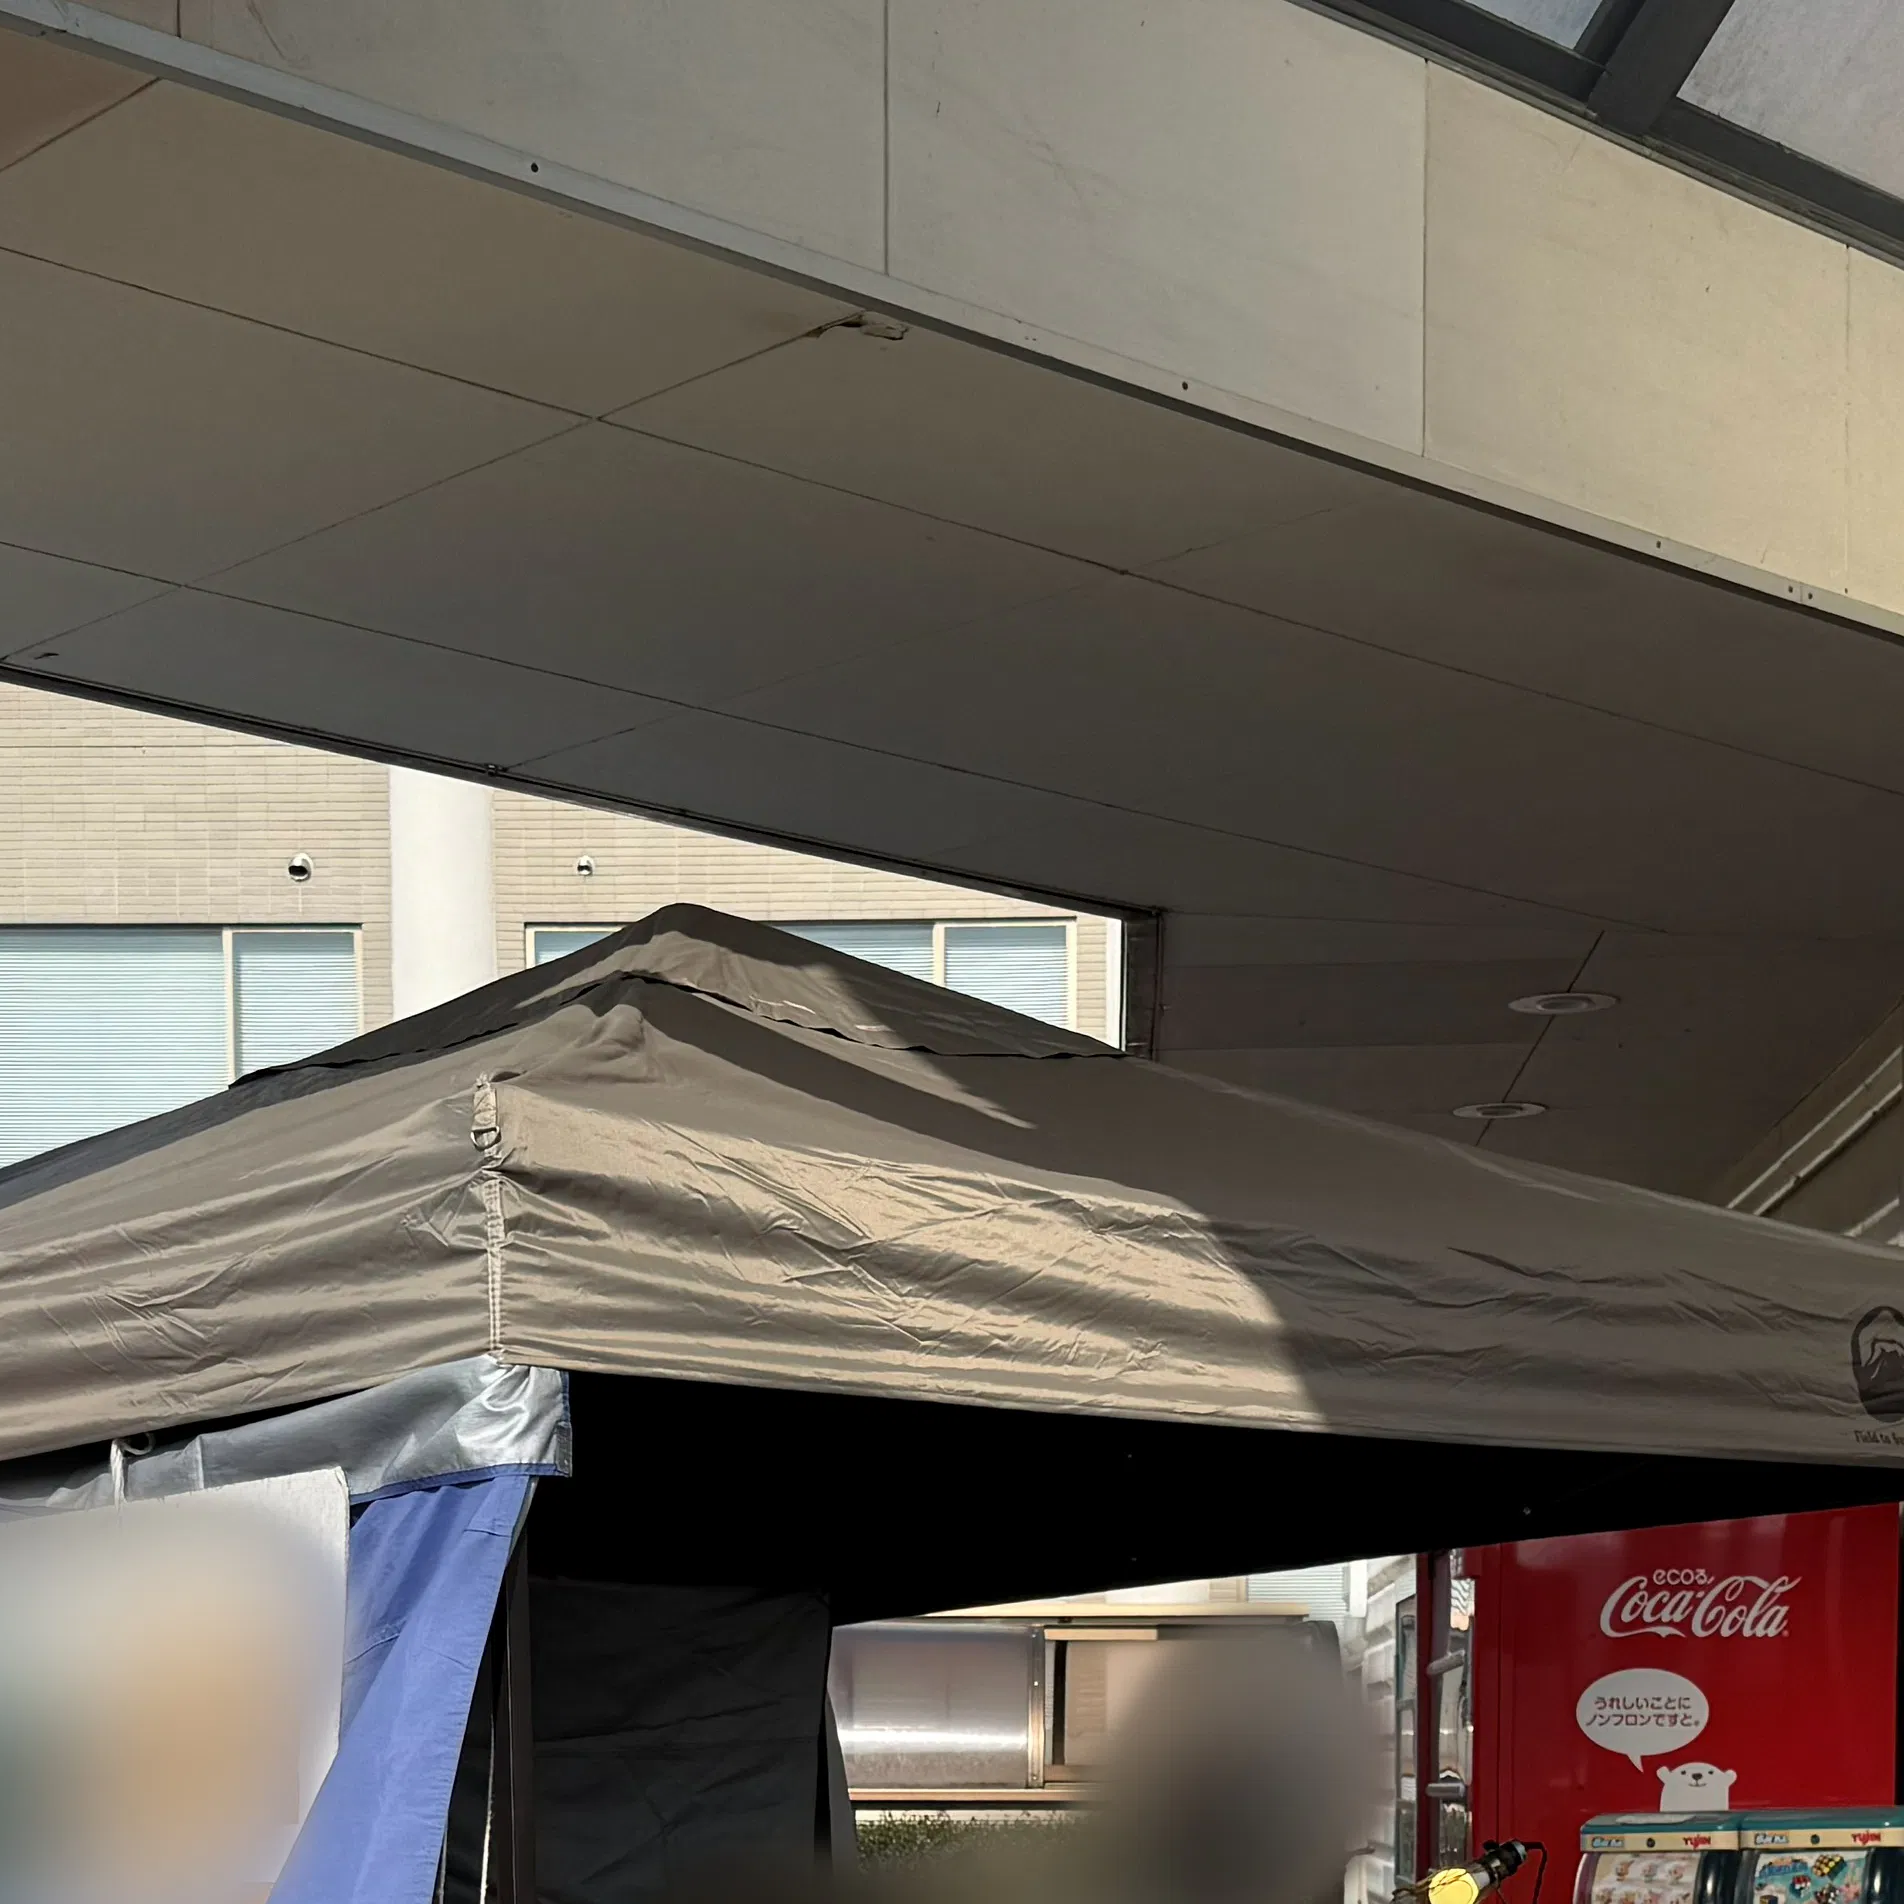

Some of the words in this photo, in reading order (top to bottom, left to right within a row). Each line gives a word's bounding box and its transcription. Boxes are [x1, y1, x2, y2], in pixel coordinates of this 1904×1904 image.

[1594, 1696, 1692, 1711] うれしいことに
